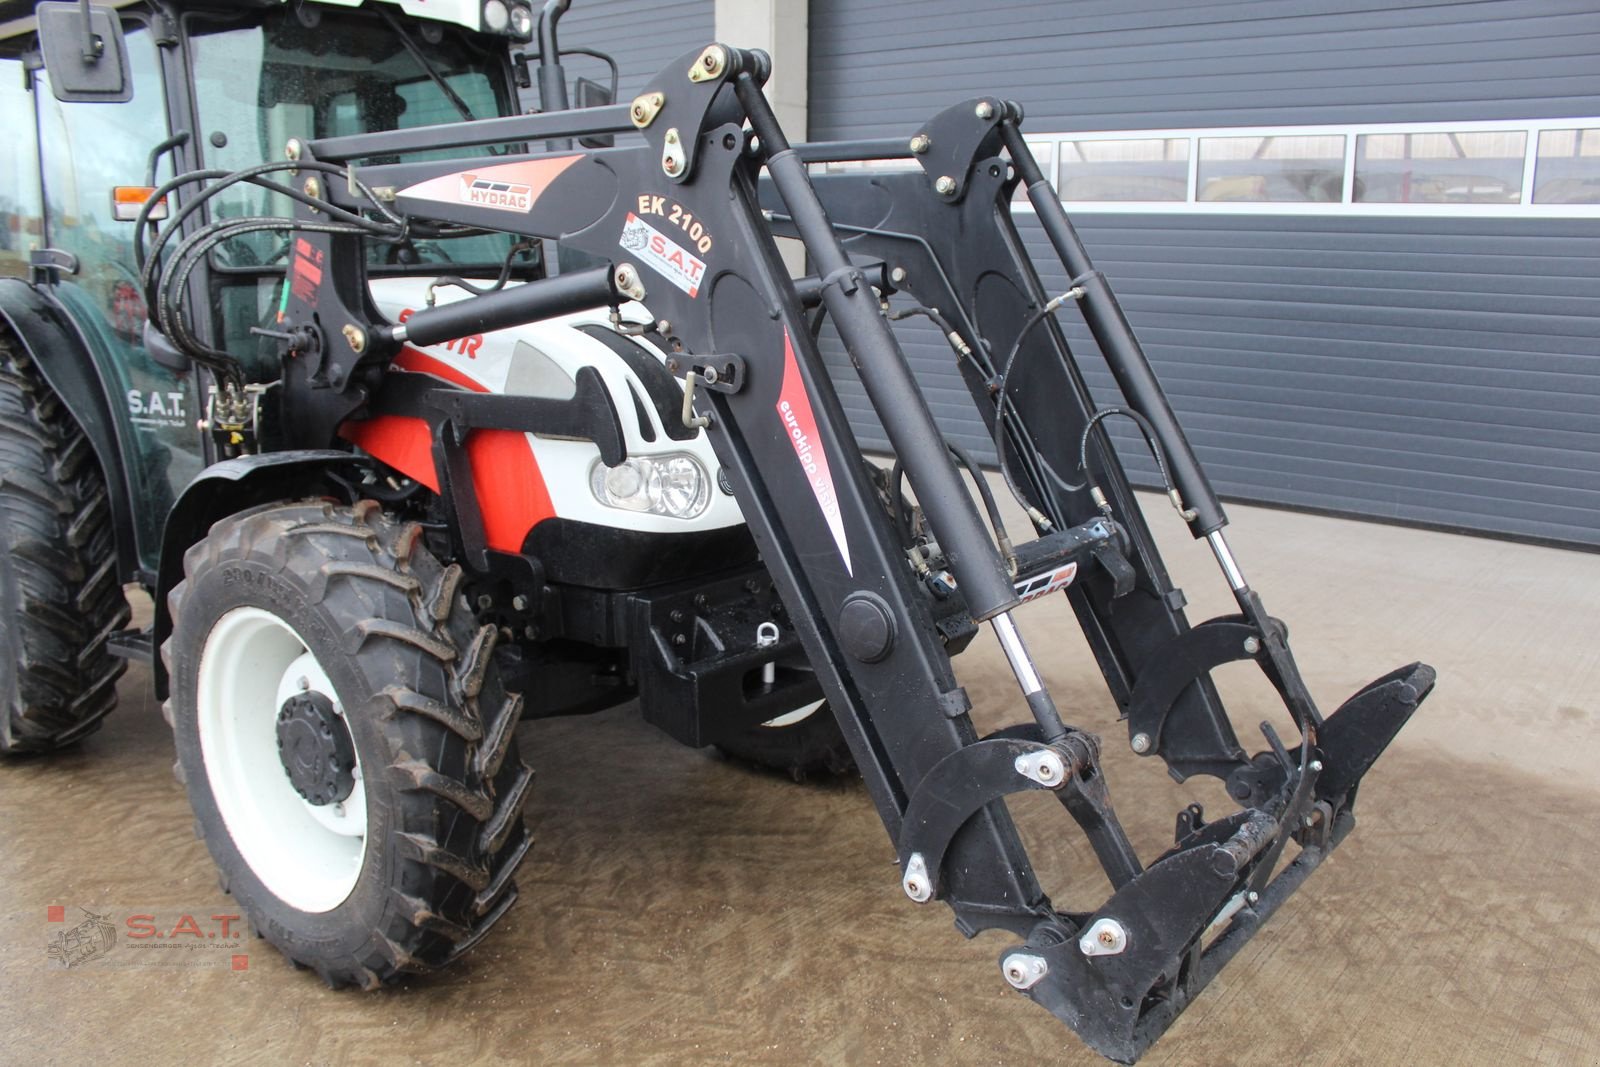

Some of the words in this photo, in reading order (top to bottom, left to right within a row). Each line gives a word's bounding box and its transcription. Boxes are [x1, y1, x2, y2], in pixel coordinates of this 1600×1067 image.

[471, 190, 526, 208] HYDRAC
[638, 194, 666, 216] EK
[668, 204, 712, 254] 2100
[650, 235, 703, 281] S.A.T.
[127, 389, 186, 417] S.A.T.
[780, 401, 817, 474] eurokipp
